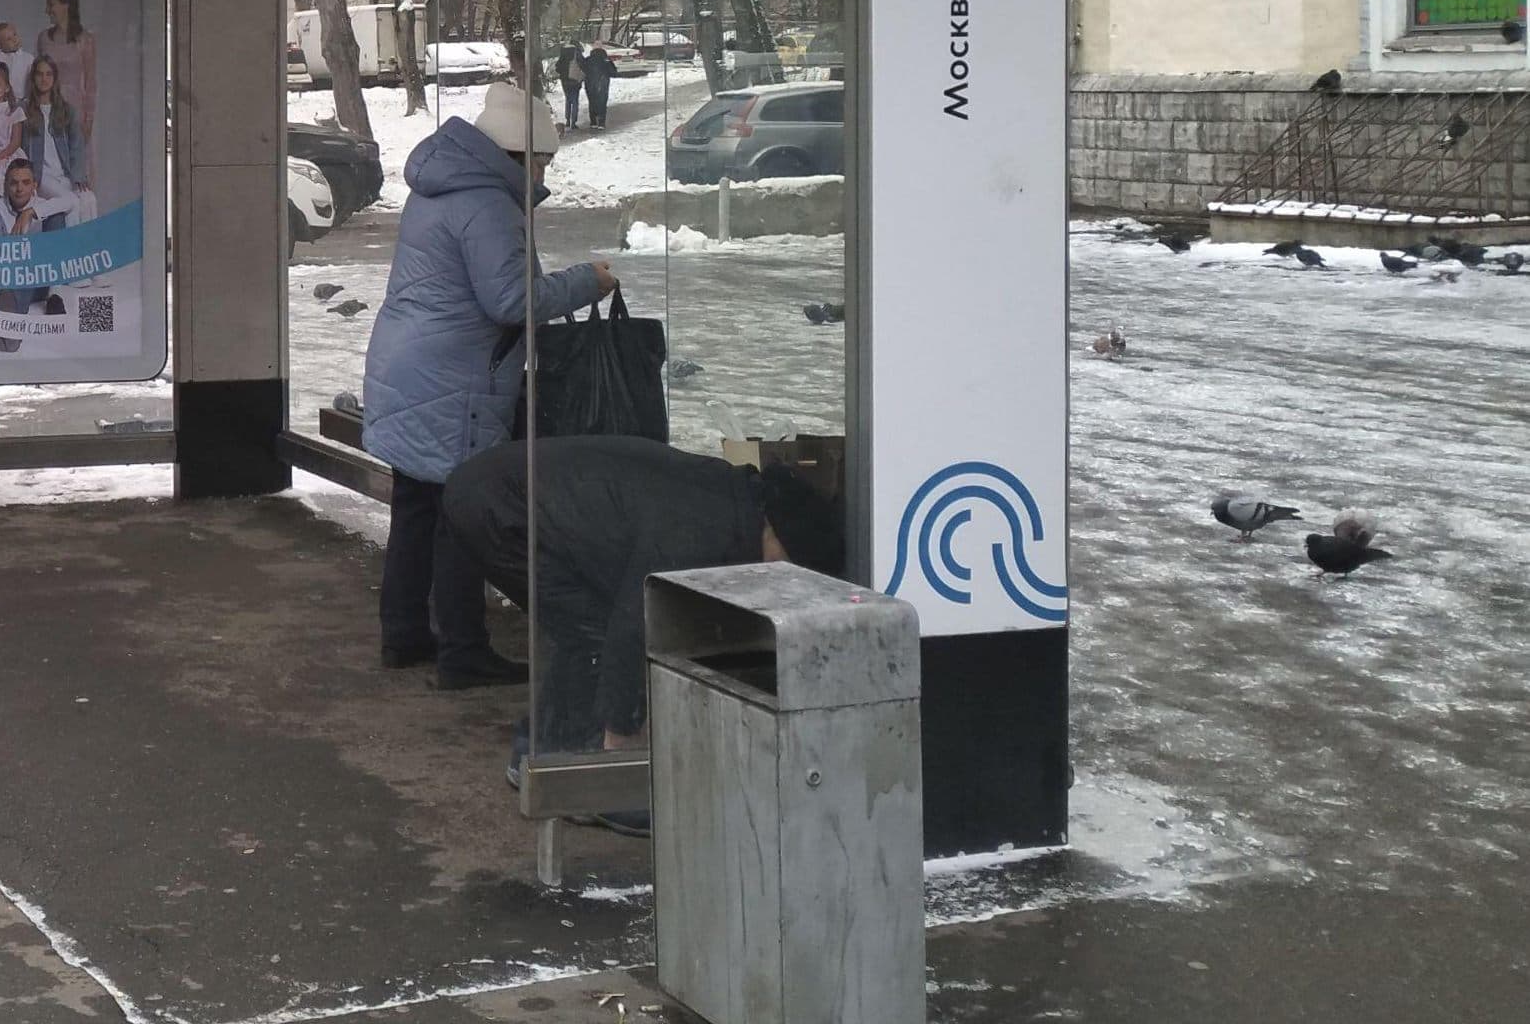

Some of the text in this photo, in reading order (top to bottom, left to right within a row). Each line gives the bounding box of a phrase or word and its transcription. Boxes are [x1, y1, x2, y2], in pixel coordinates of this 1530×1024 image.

[15, 263, 58, 286] БЫТЬ
[60, 249, 113, 279] МНОГО
[0, 319, 27, 333] СЕМЕЙ
[33, 323, 66, 335] ДЕТЬМИ
